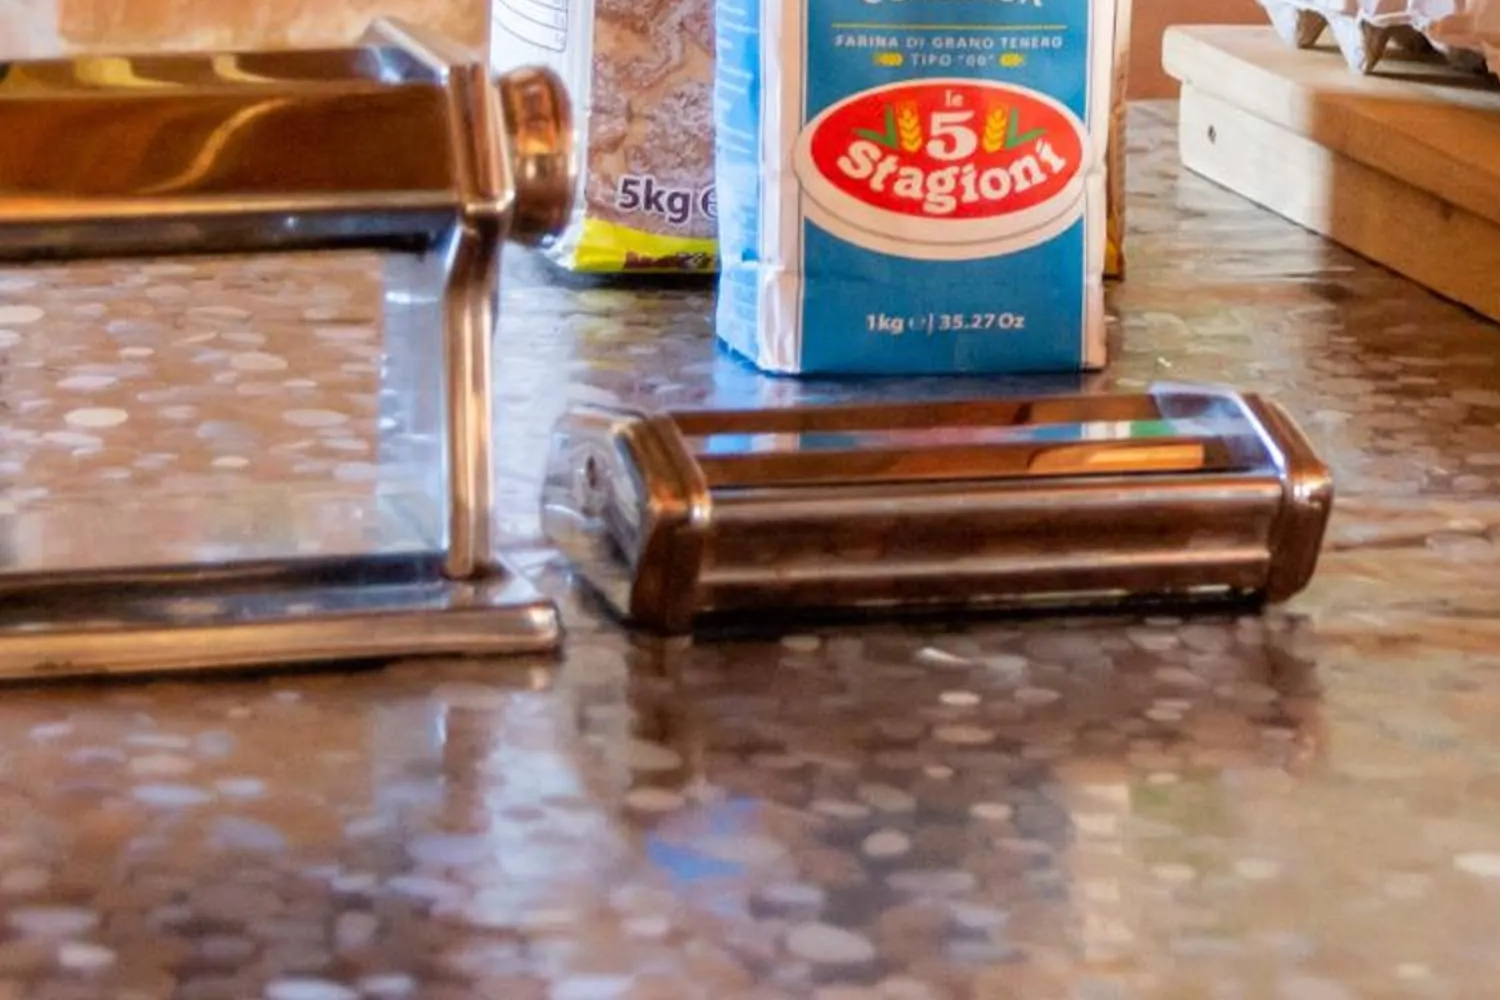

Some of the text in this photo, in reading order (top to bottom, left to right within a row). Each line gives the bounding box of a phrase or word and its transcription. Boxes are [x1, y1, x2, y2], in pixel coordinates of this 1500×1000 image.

[834, 34, 1064, 49] FARINA DI GRANO TENERO
[911, 52, 952, 67] TIPO
[944, 89, 965, 107] le
[925, 110, 979, 161] 5
[836, 138, 1067, 214] Stagioni
[618, 178, 691, 224] 5kg
[866, 312, 904, 335] 1kg
